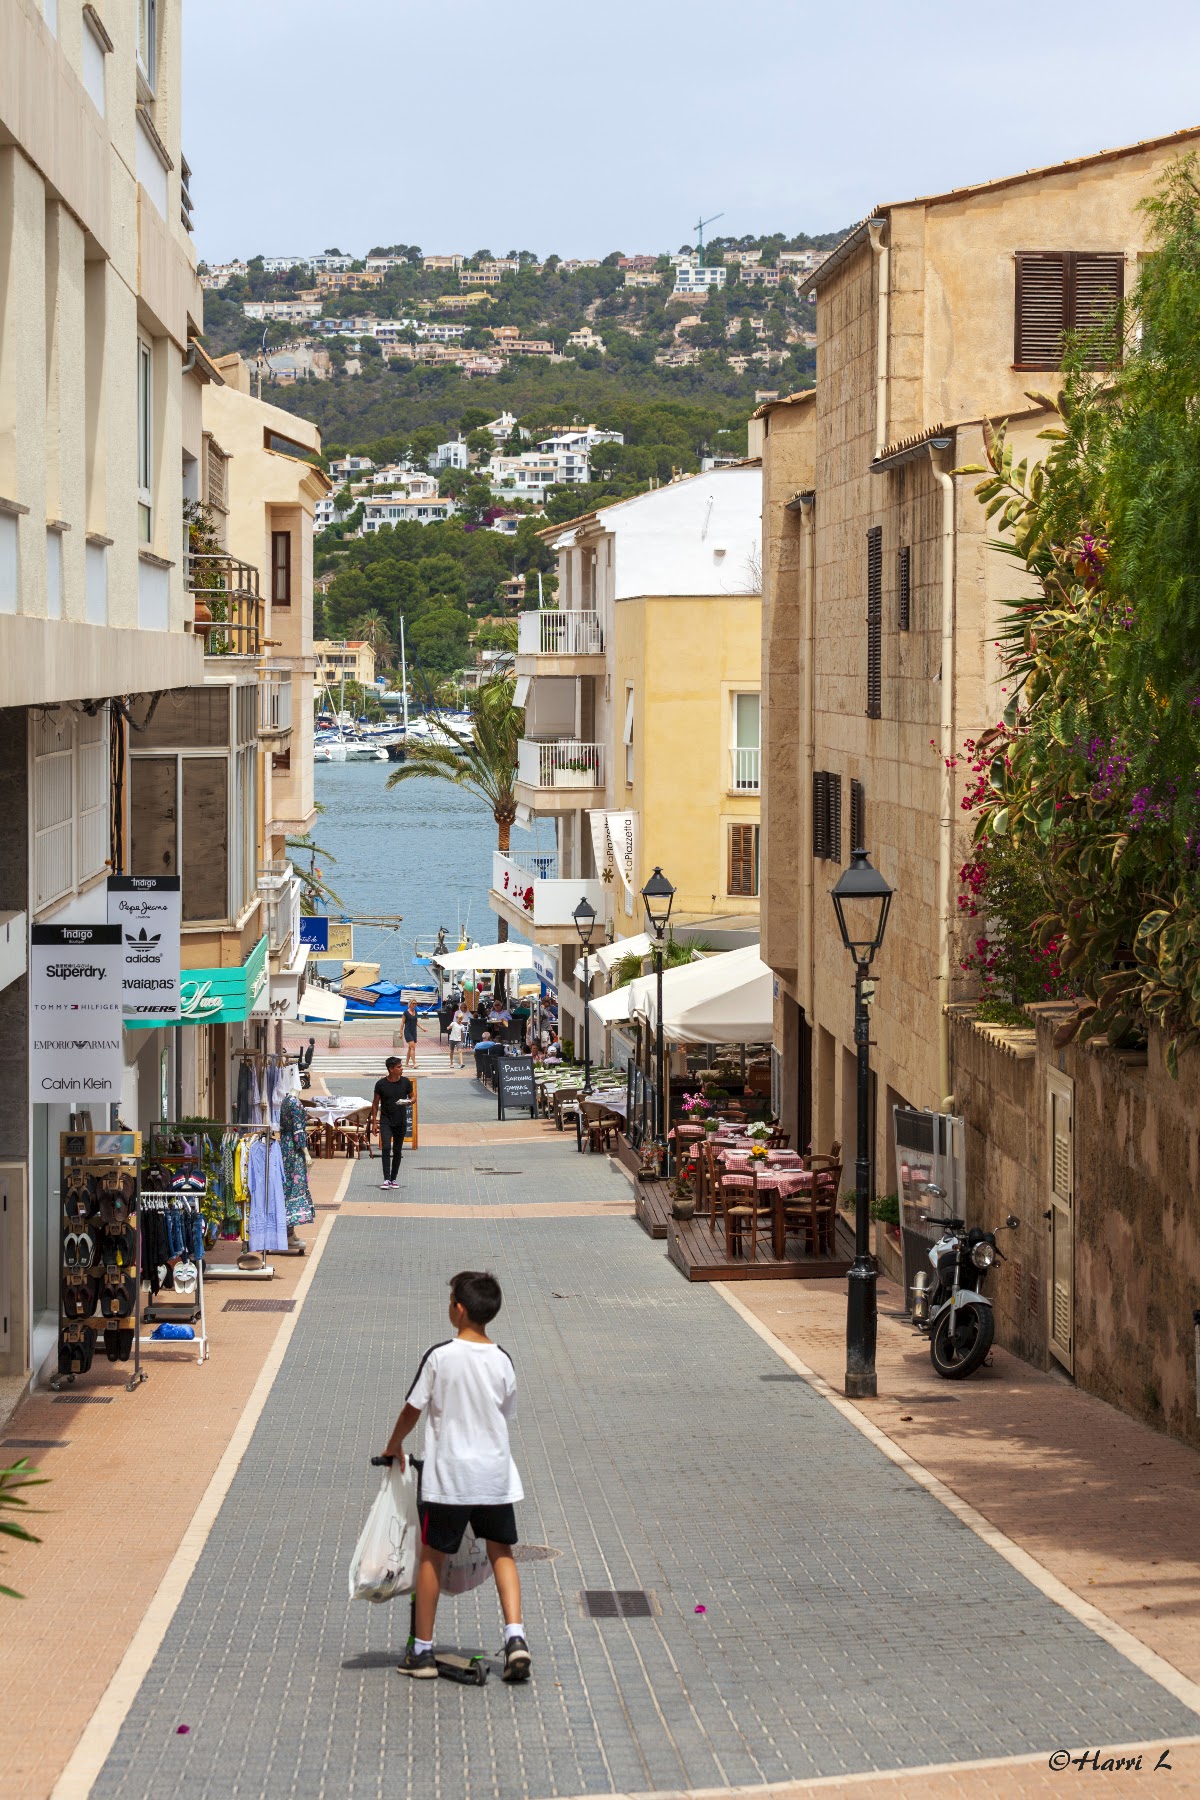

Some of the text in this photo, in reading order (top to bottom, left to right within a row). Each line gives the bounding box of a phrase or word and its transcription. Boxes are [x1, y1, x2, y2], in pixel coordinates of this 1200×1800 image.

[131, 878, 157, 888] Indigo
[119, 900, 168, 915] Pepe Jeans
[60, 927, 93, 941] Indigo
[125, 954, 161, 963] adidas
[122, 979, 174, 990] avaianas
[34, 1040, 120, 1050] EMPORIO ARMANI
[41, 1077, 112, 1090] Calvin Klein
